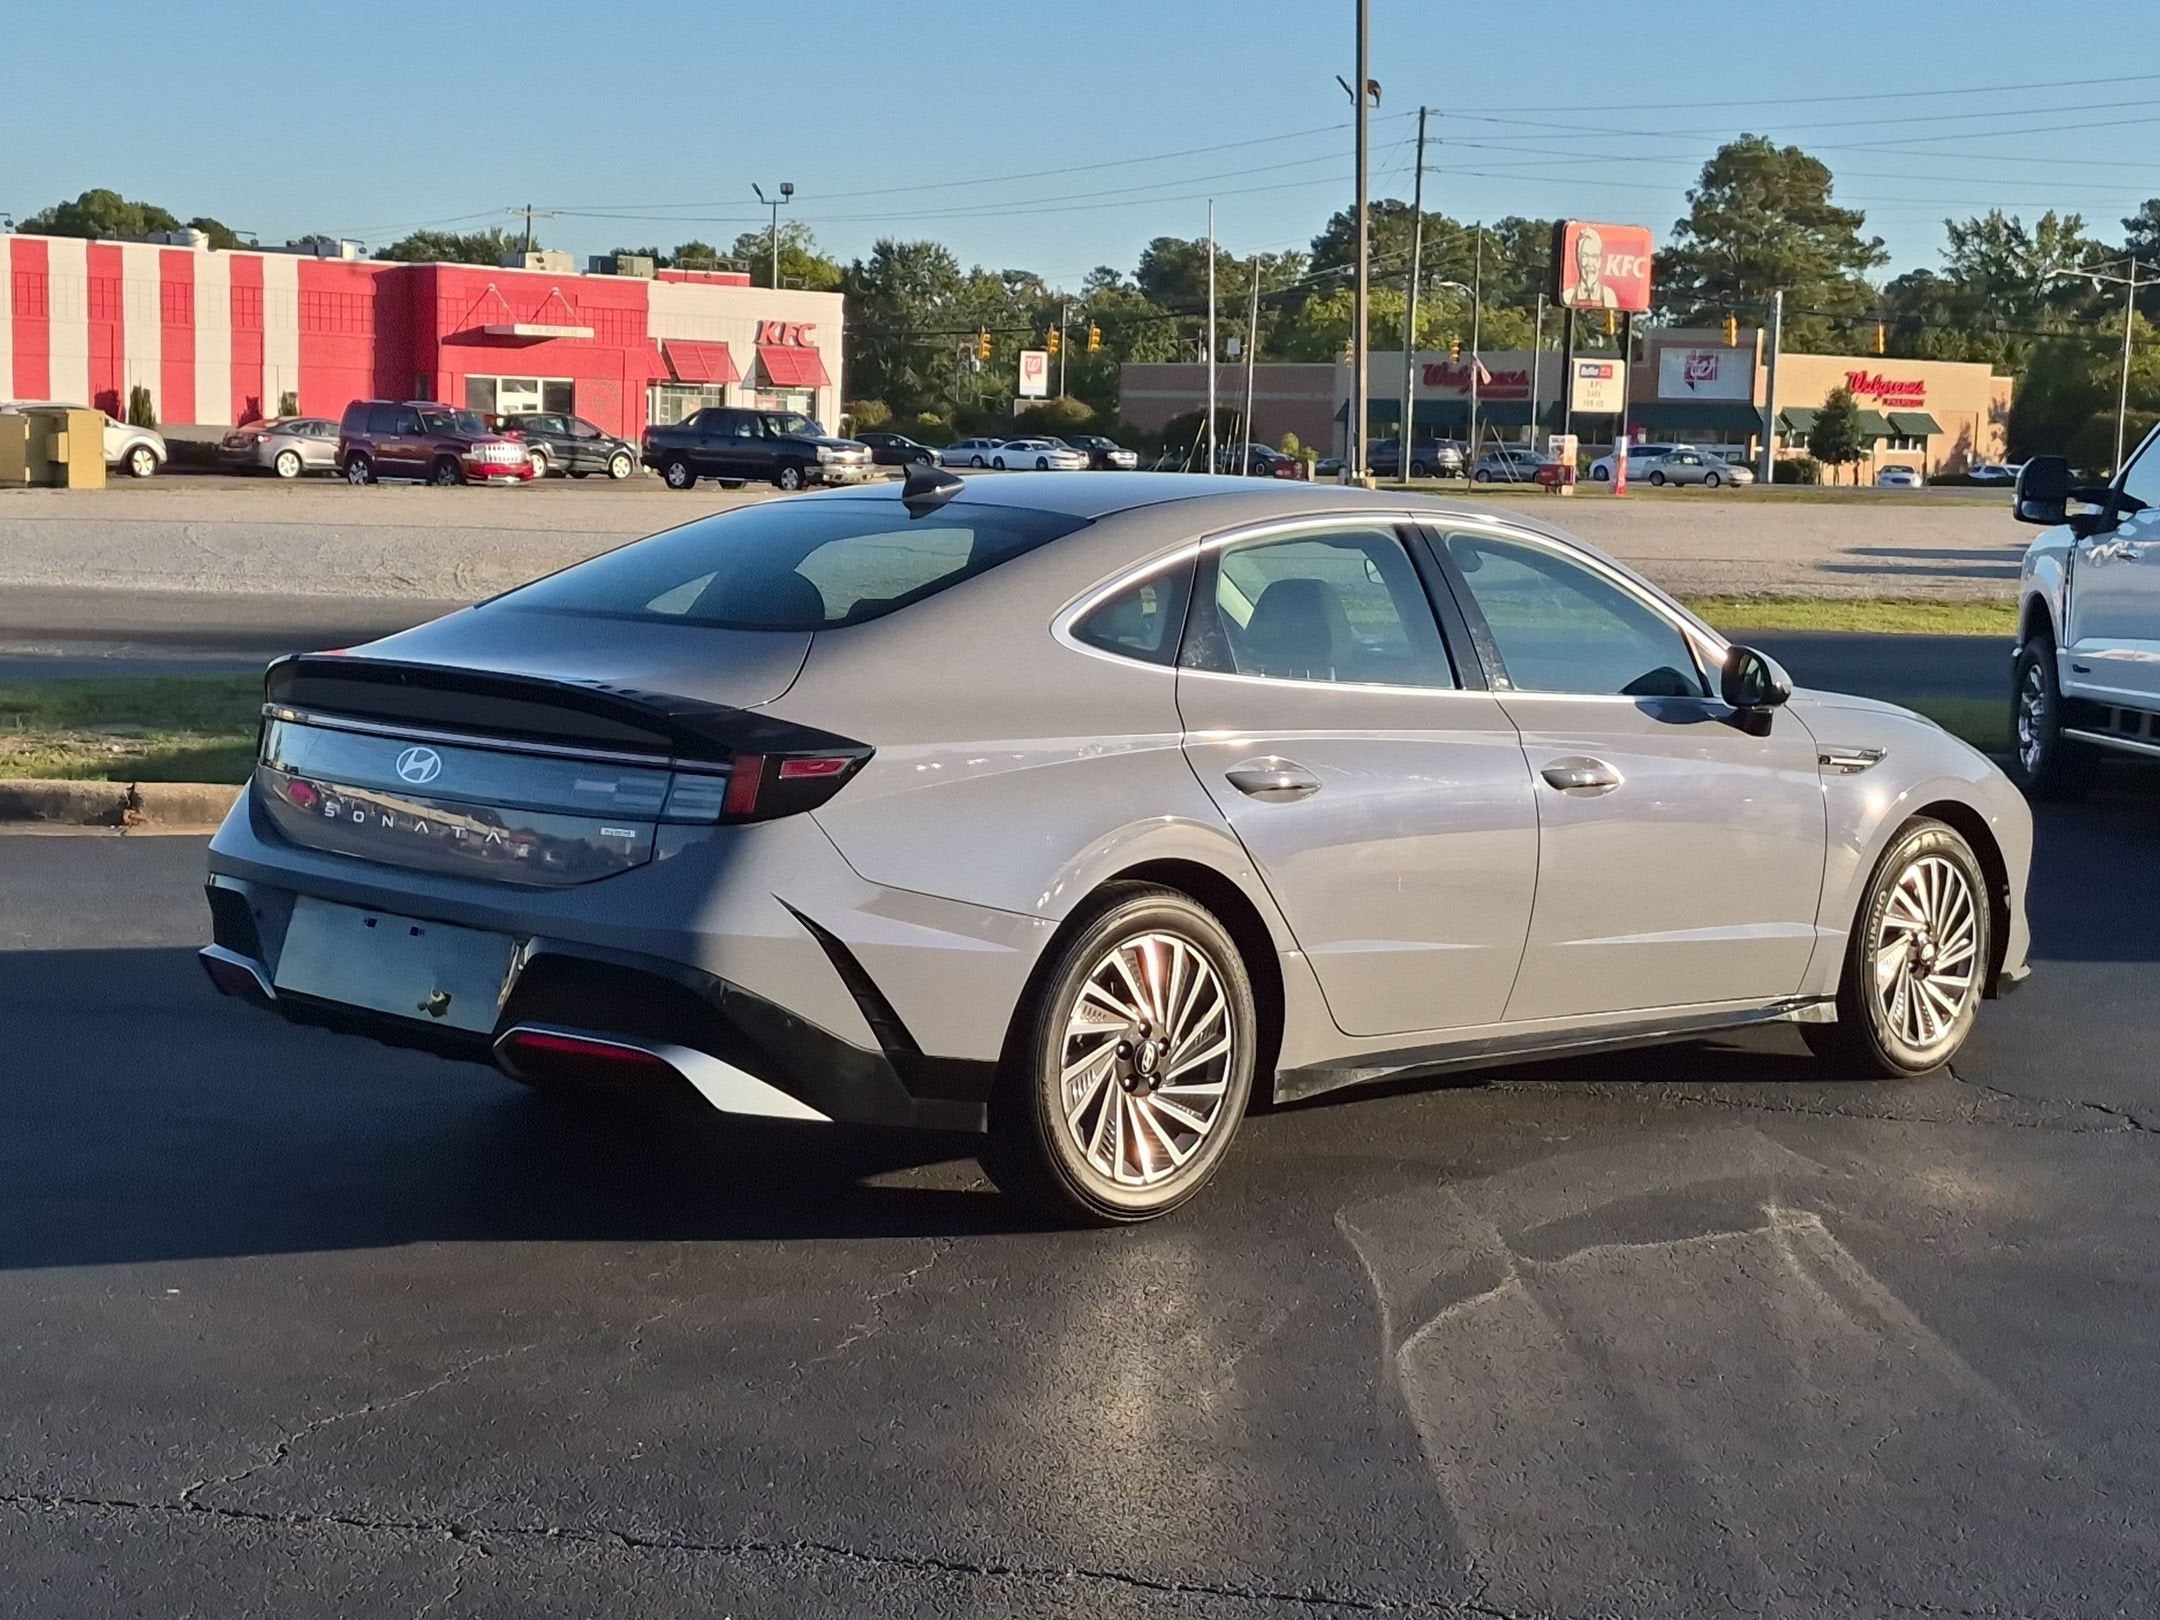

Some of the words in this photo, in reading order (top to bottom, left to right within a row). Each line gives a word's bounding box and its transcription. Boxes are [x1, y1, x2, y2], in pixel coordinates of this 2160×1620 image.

[1604, 253, 1646, 278] KFC
[755, 320, 816, 347] KFC
[1844, 370, 1927, 402] Walgreens
[324, 801, 502, 845] SONATA
[1867, 890, 1888, 963] KUMHO
